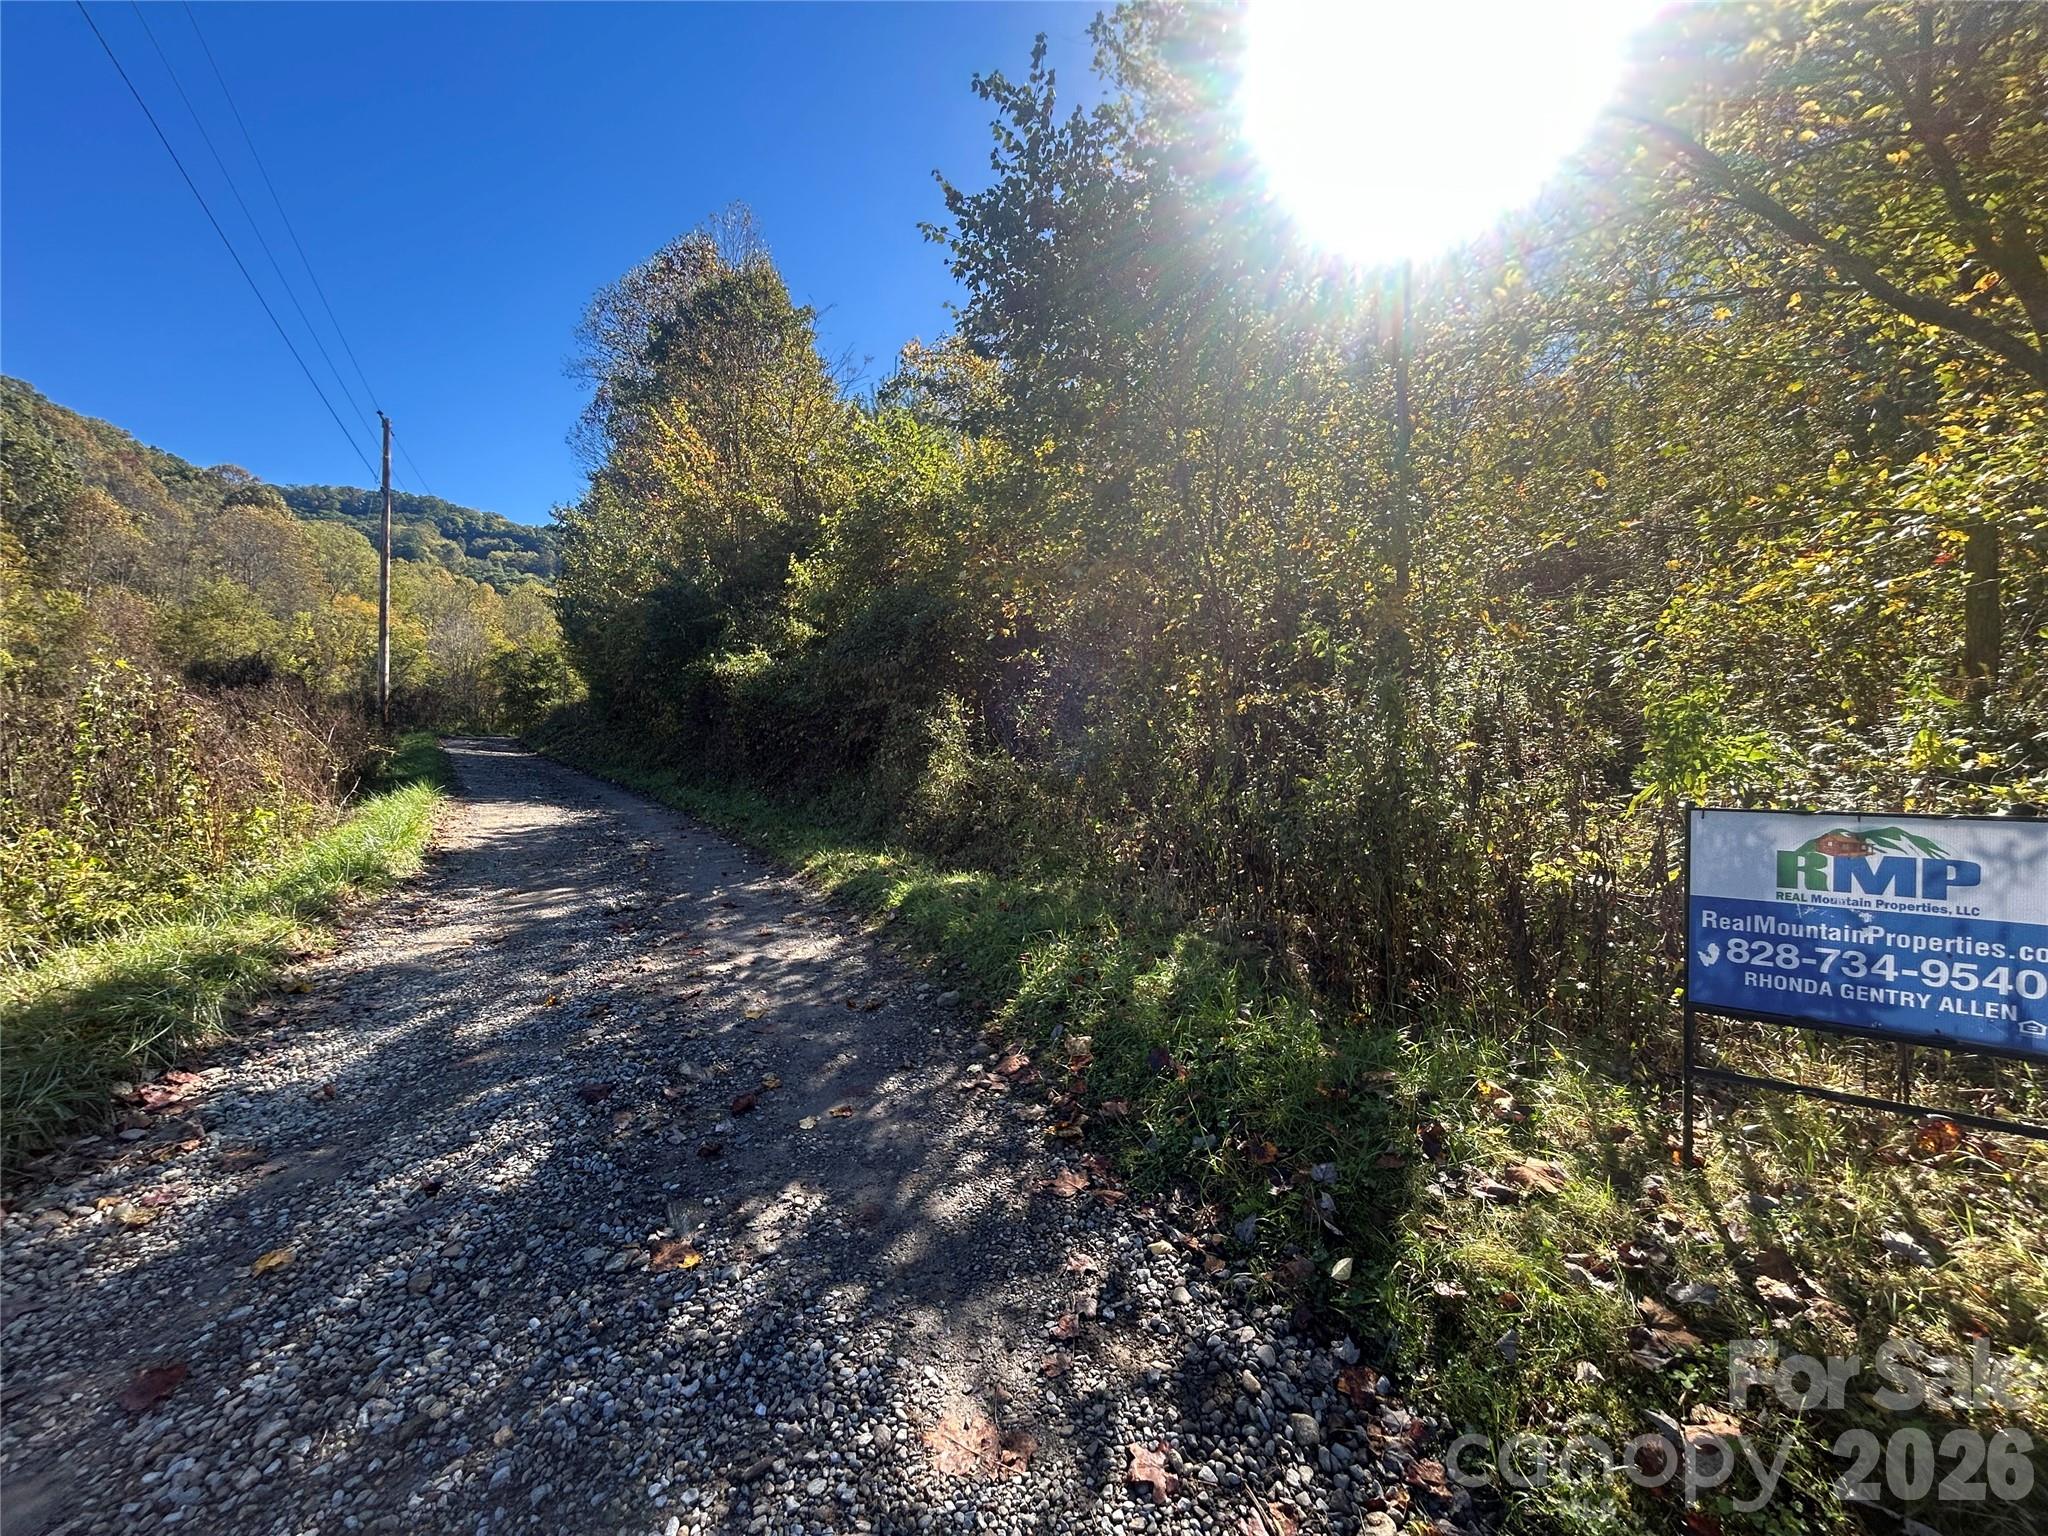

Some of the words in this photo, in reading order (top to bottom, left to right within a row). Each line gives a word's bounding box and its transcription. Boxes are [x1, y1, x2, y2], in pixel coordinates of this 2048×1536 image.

[1776, 850, 1981, 901] RMP
[1776, 891, 1808, 903] REAL
[1811, 894, 1871, 909] Mountain
[1875, 899, 1952, 916] Properties,
[1956, 906, 1980, 917] LLC
[1726, 937, 2048, 1000] 828-734-9540
[1744, 971, 1833, 997] RHONDA
[1840, 983, 1931, 1010] GENTRY
[1938, 996, 2018, 1022] ALLEN
